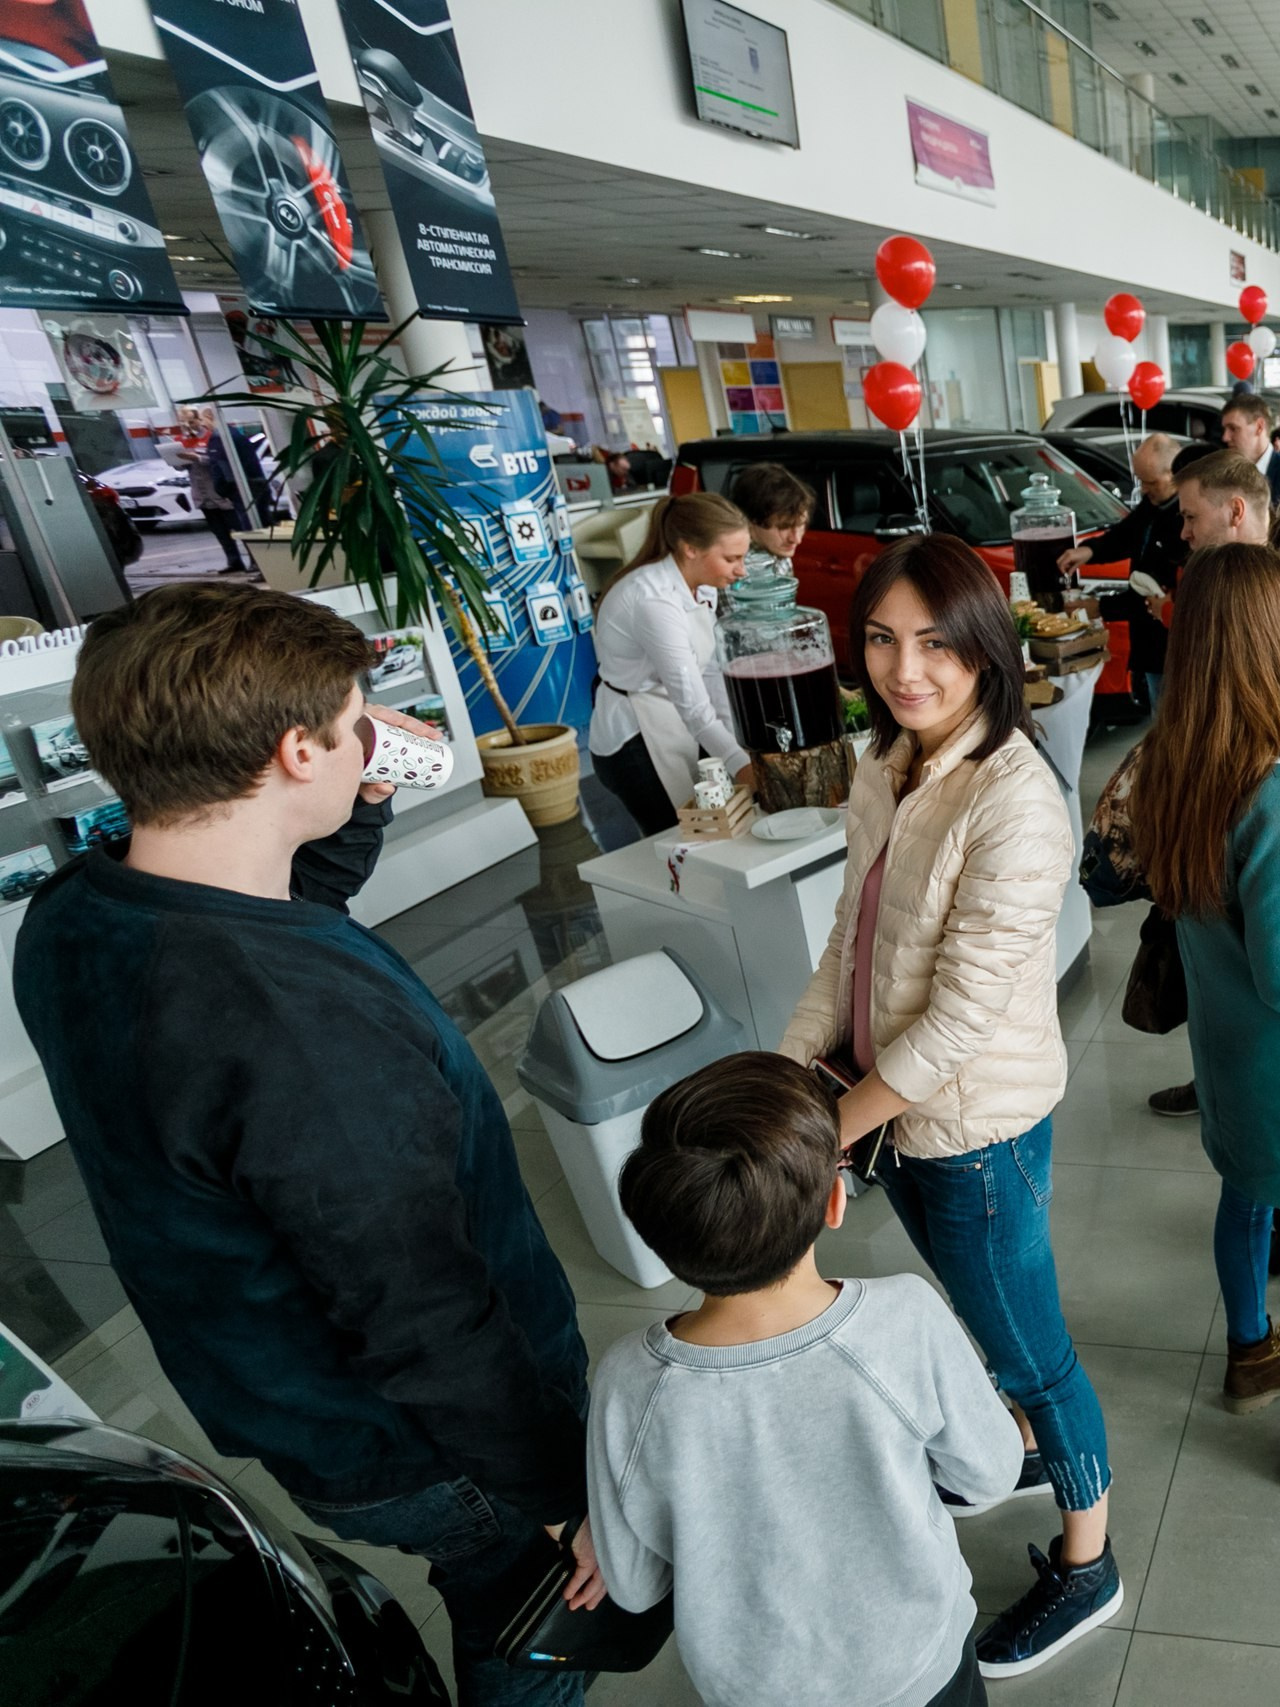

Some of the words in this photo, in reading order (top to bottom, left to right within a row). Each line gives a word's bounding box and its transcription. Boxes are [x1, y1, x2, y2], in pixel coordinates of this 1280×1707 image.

[418, 223, 490, 245] 8-СТУПЕНЧАТАЯ
[417, 238, 497, 261] АВТОМАТИЧЕСКАЯ
[428, 256, 493, 275] ТРАНСМИССИЯ
[397, 404, 458, 420] Кждой
[502, 450, 539, 476] ВТБ
